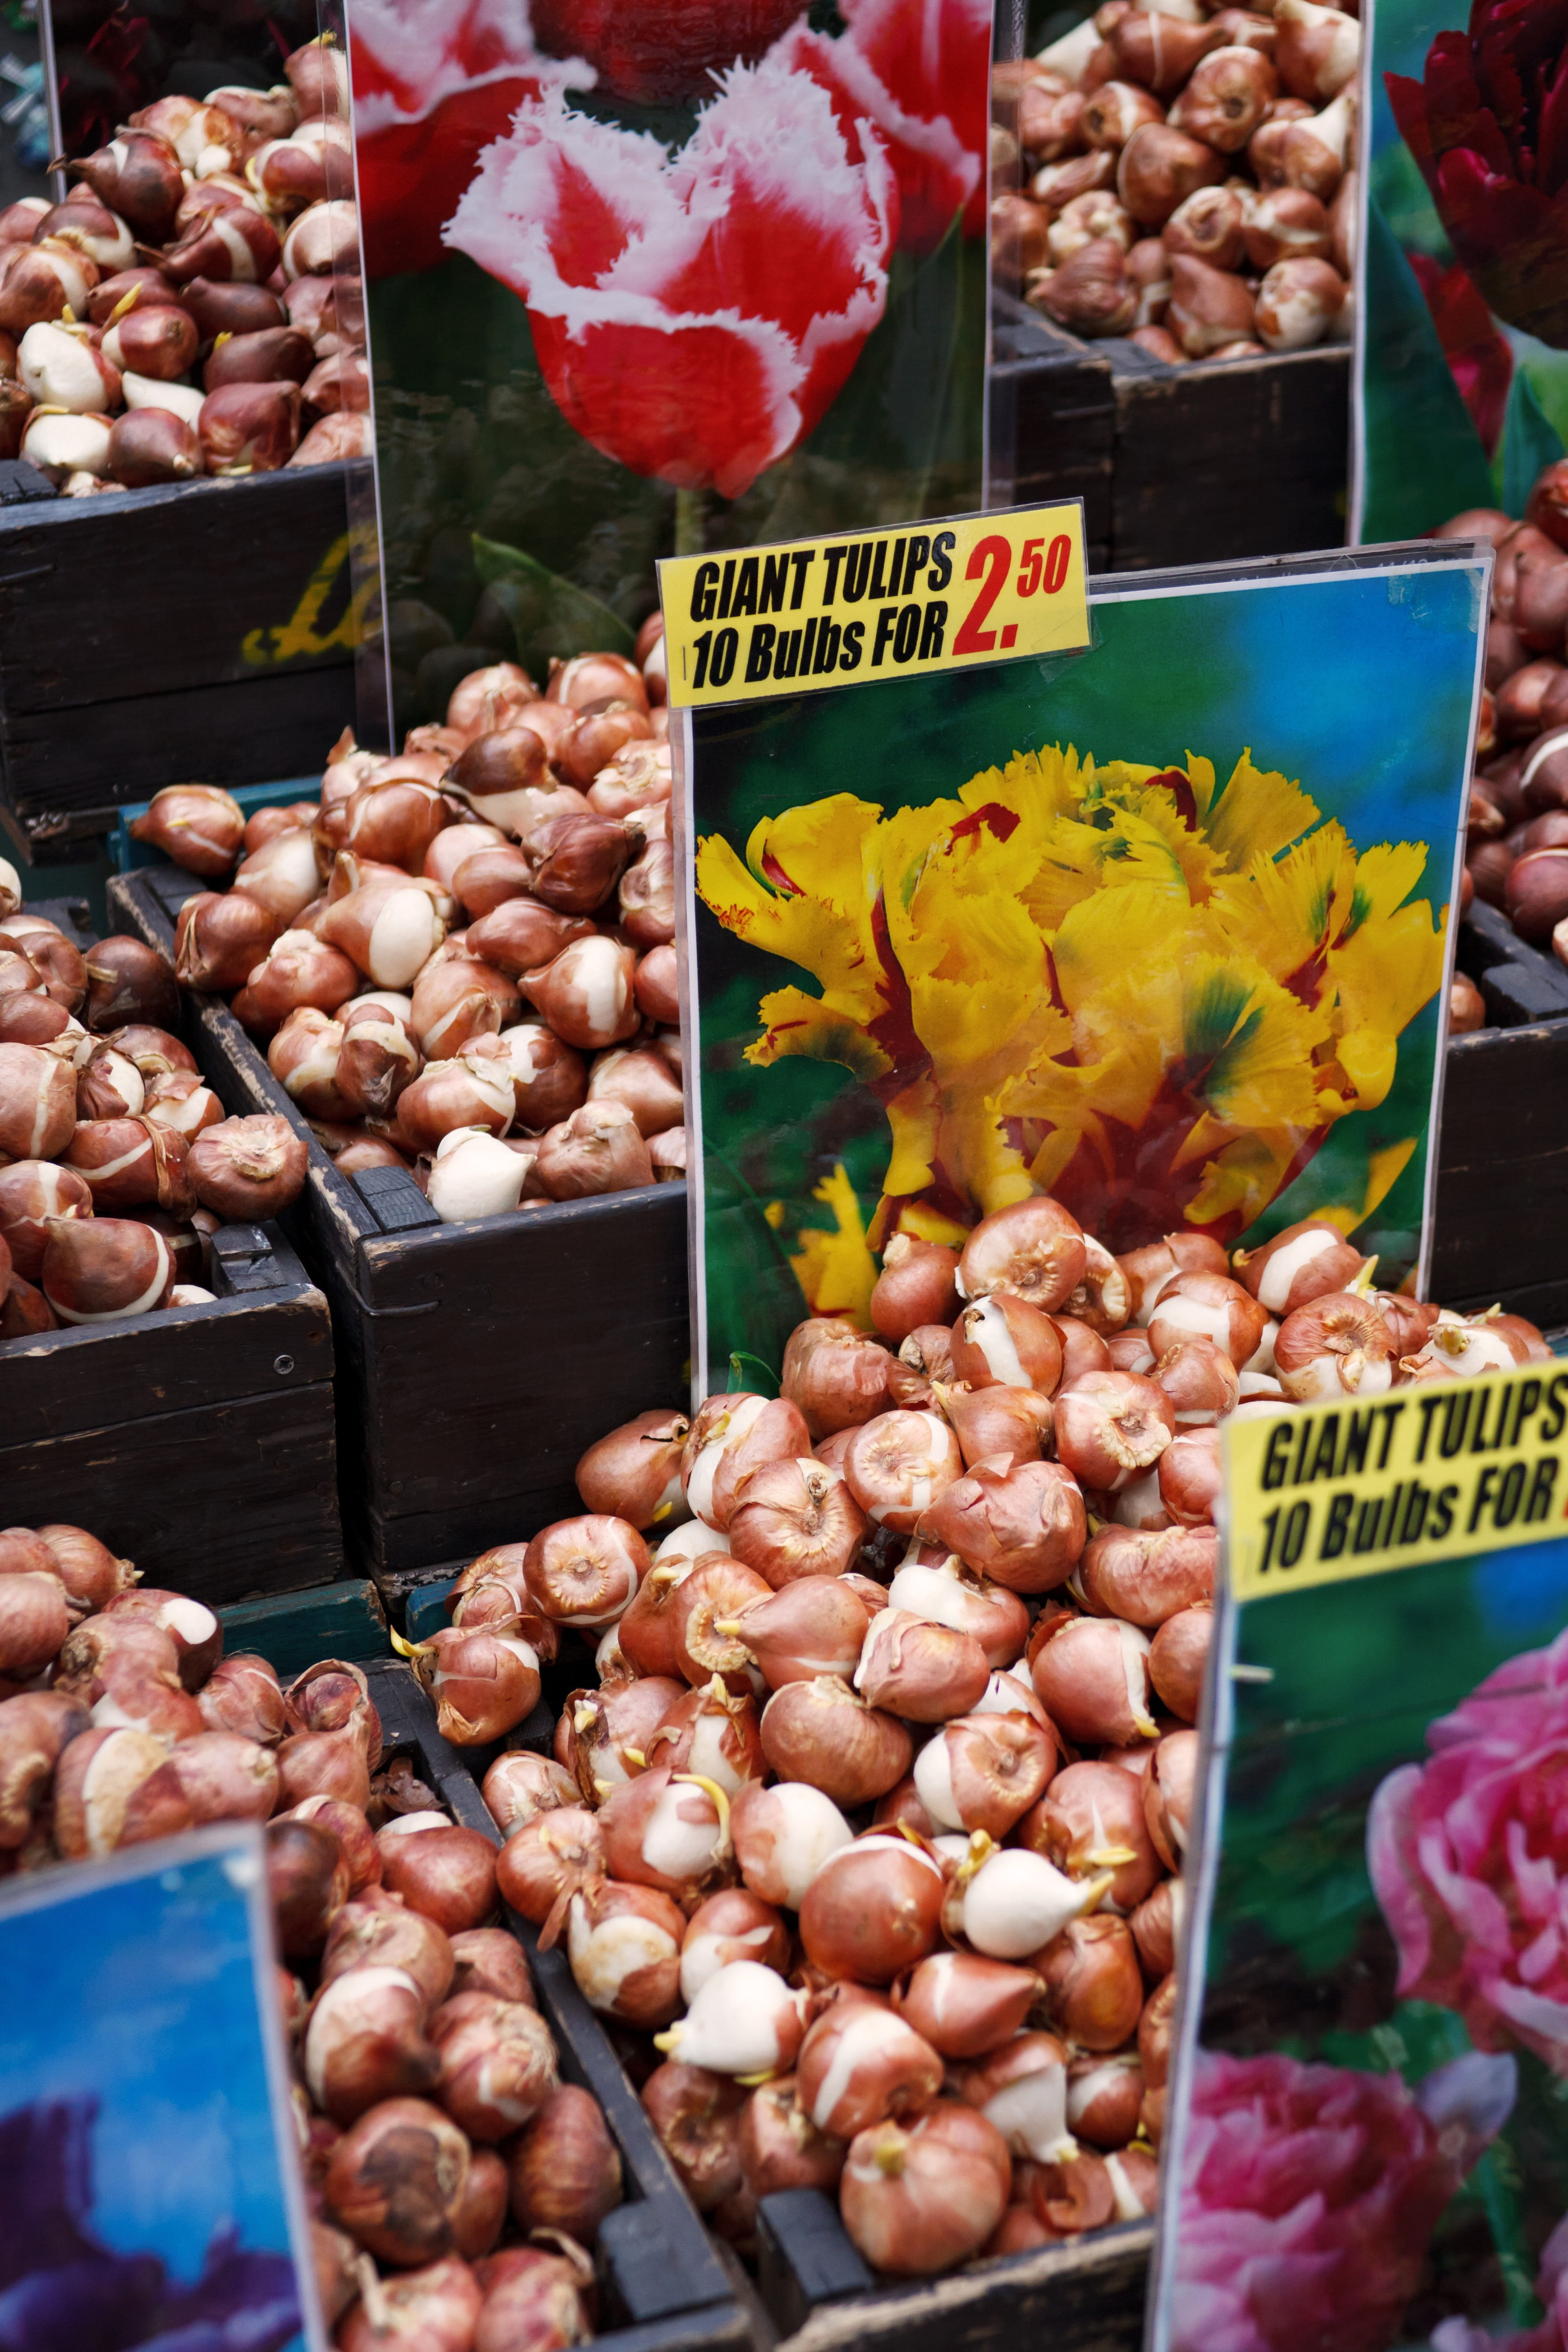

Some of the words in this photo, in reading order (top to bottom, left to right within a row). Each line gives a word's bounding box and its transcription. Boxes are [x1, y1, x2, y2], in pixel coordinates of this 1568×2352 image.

[690, 549, 816, 623] GIANT
[822, 531, 956, 606] TULIPS
[692, 627, 739, 689] 10
[744, 615, 866, 683] Bulbs
[871, 600, 948, 667] FOR
[1261, 1402, 1406, 1492] GIANT
[1415, 1373, 1568, 1463] TULIPS
[1260, 1501, 1312, 1573] 10
[1318, 1479, 1460, 1561] Bulbs
[1466, 1456, 1559, 1534] FOR
